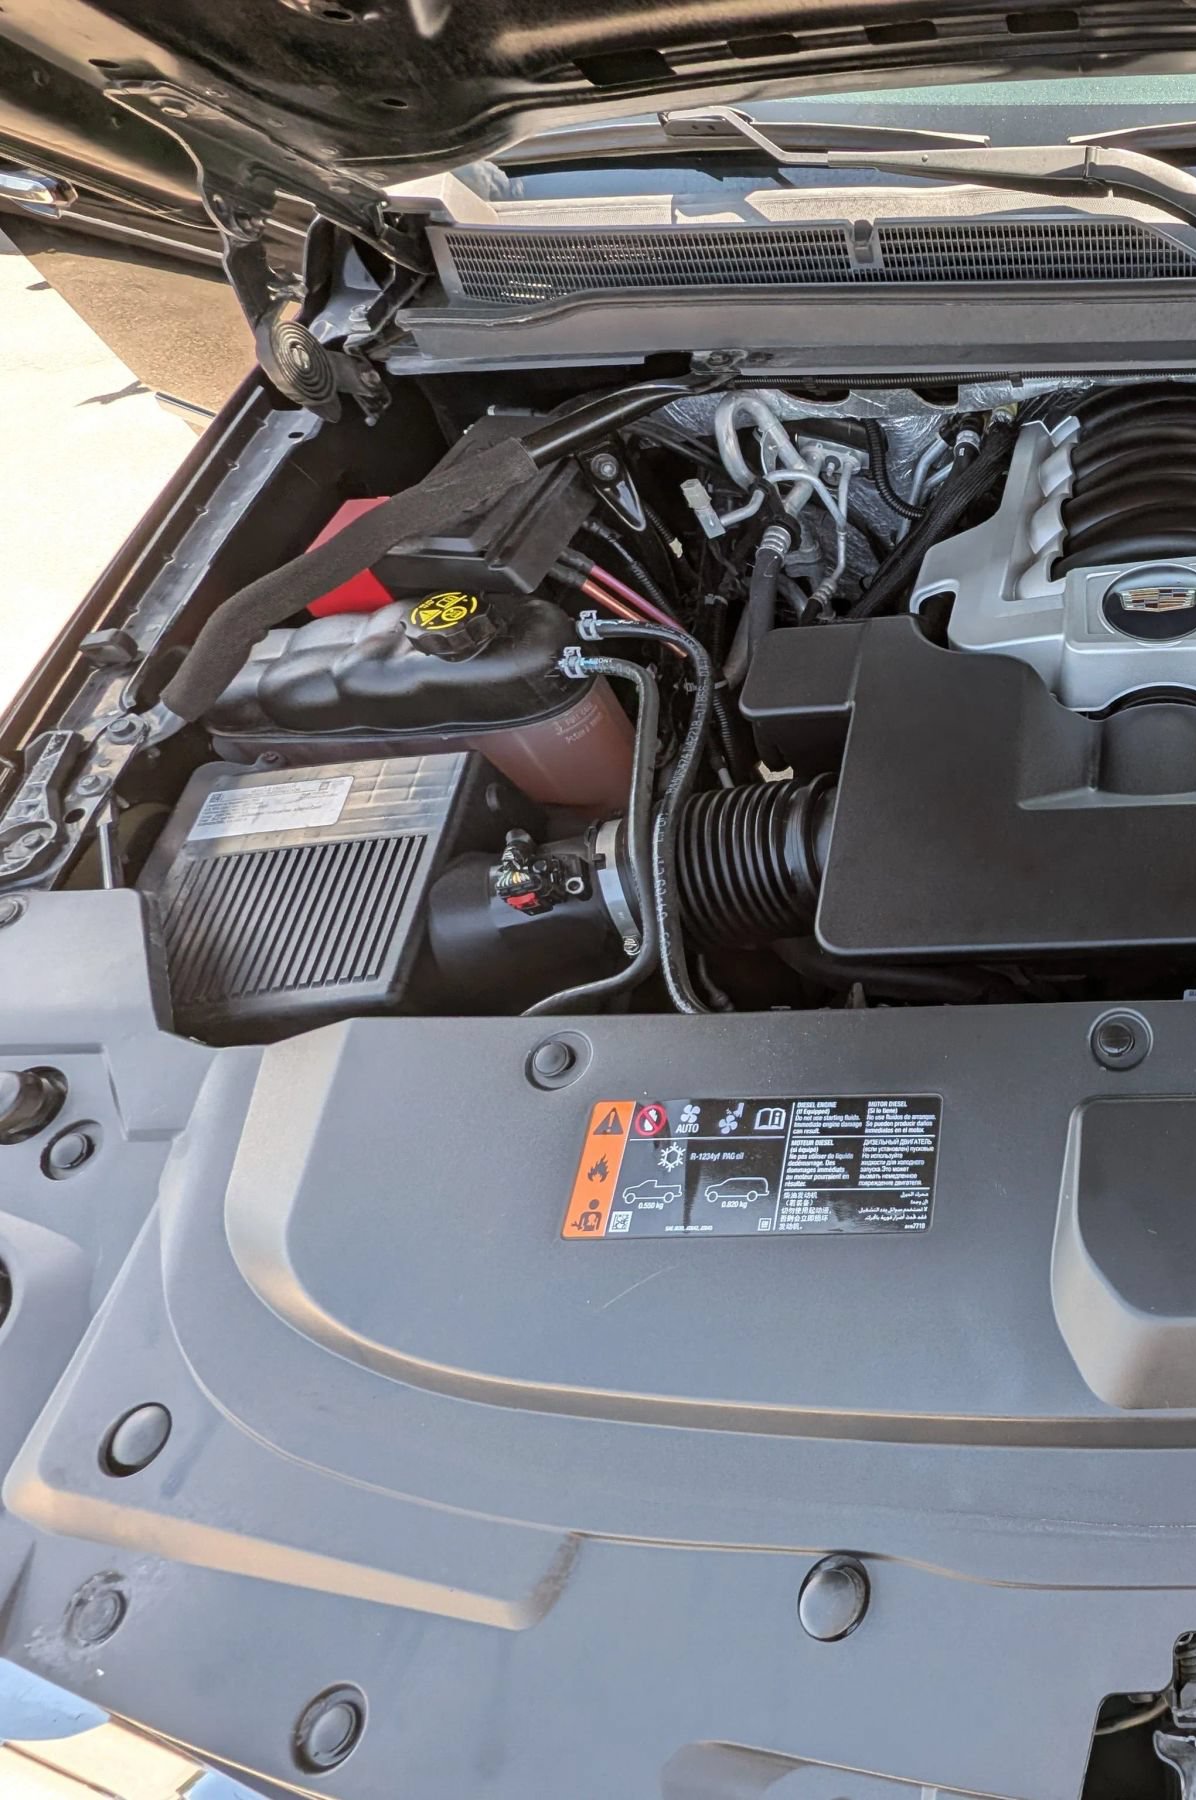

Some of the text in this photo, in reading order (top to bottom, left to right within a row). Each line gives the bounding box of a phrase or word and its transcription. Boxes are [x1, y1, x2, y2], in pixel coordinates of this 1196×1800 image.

[675, 1123, 699, 1133] AUTO
[690, 1153, 720, 1162] R-1234yf
[656, 1202, 664, 1210] kg
[739, 1200, 748, 1209] kg
